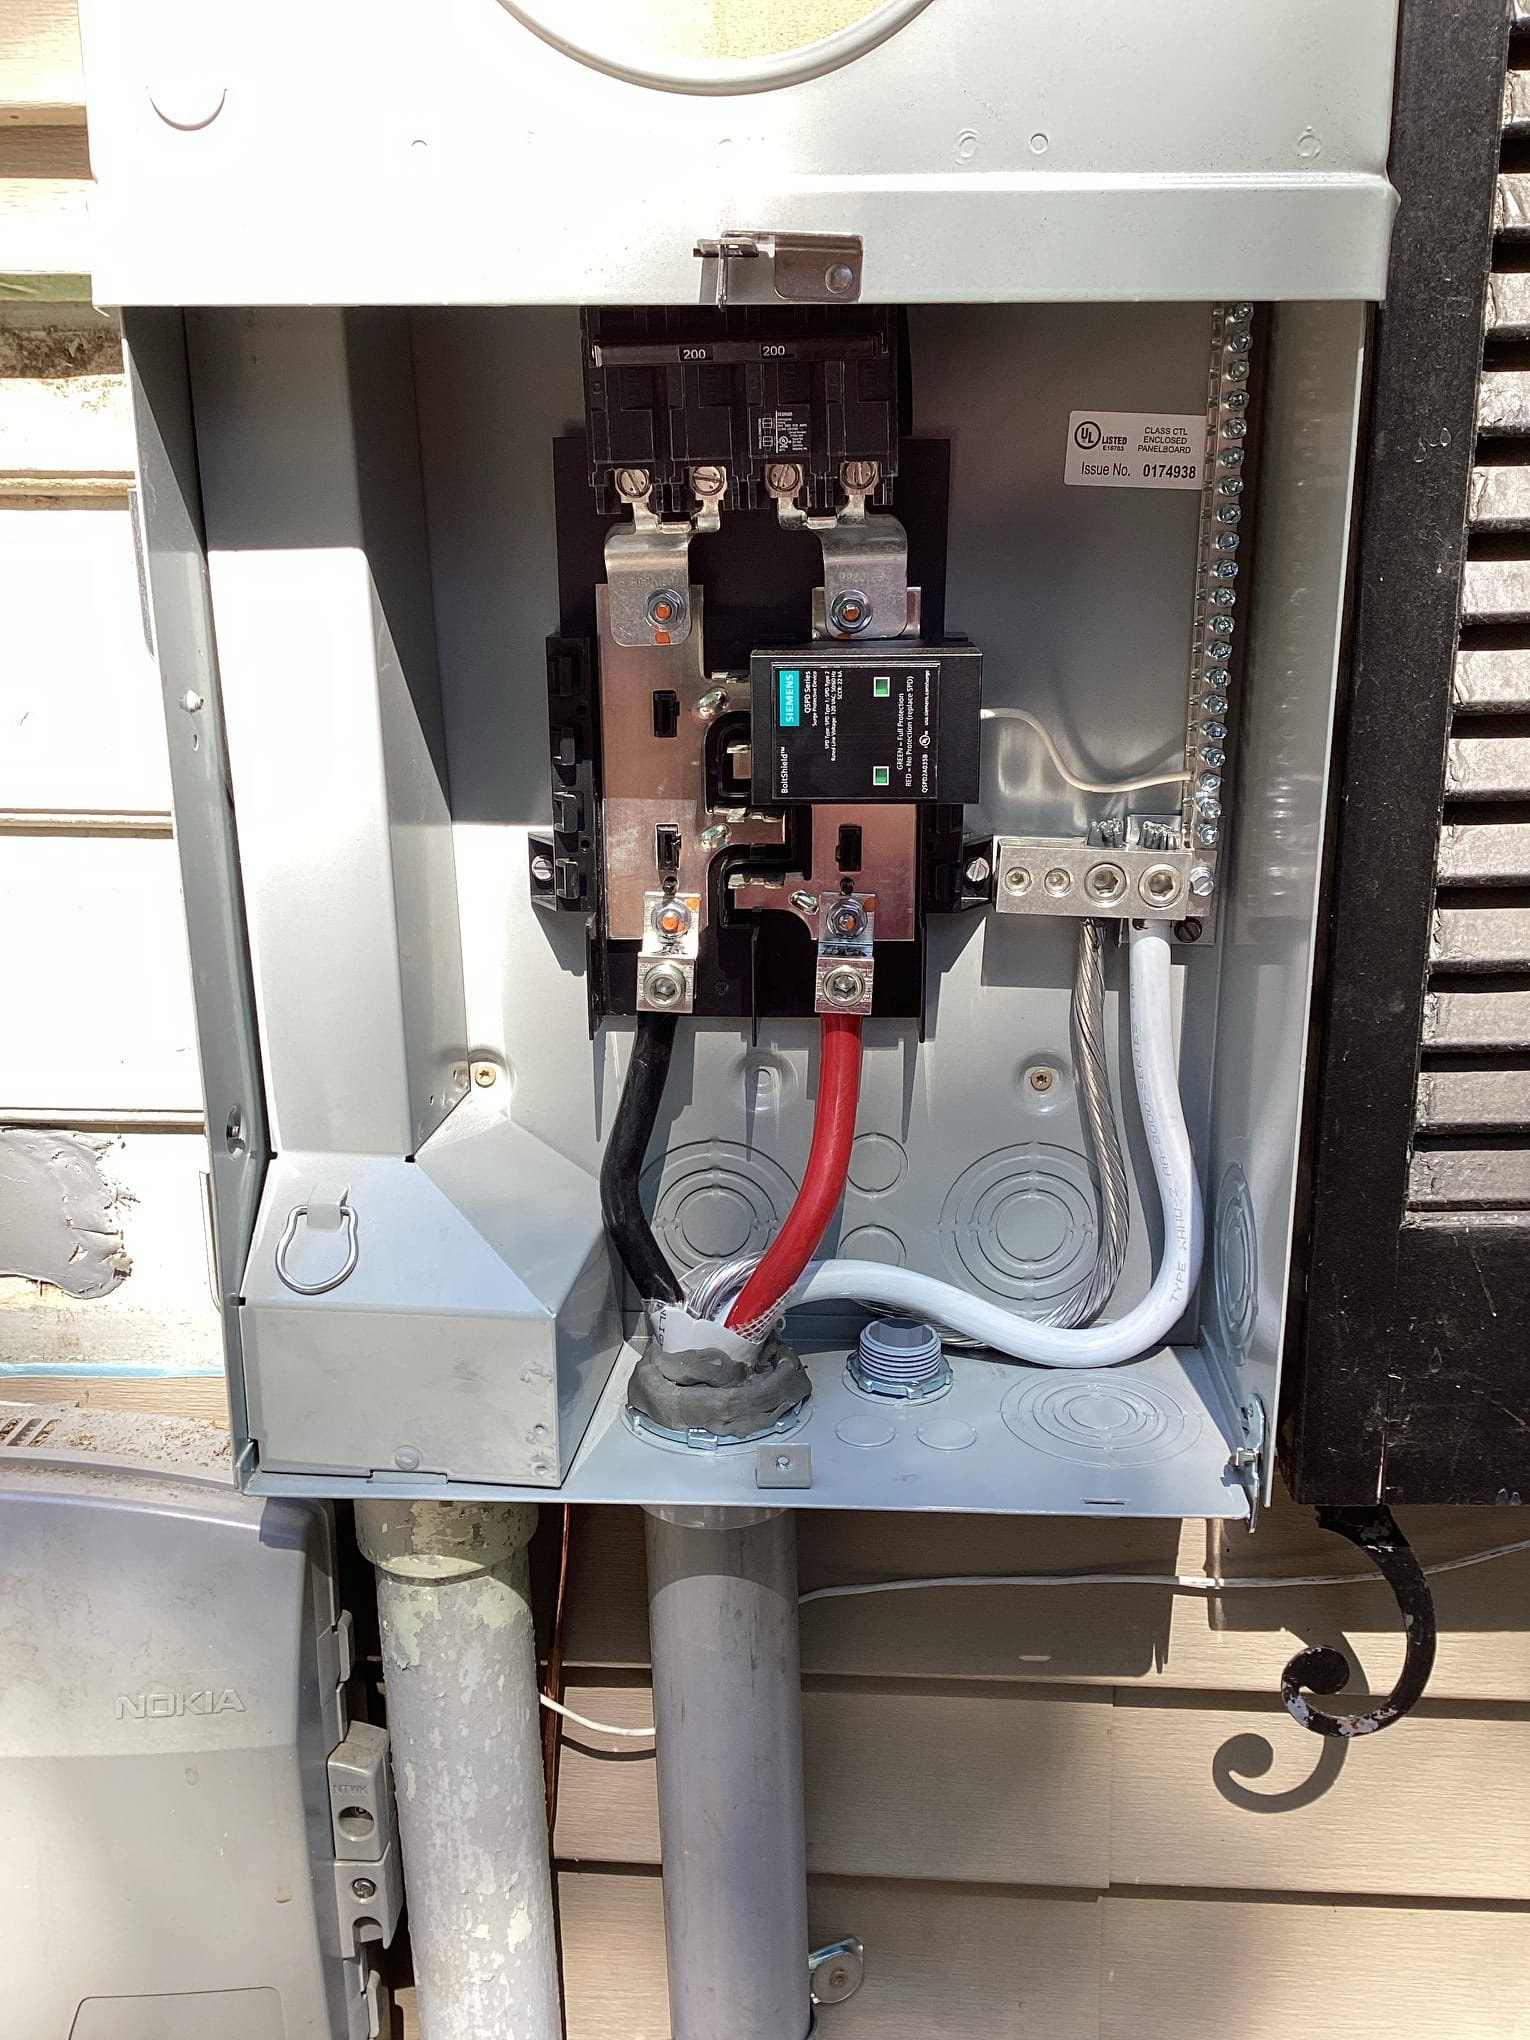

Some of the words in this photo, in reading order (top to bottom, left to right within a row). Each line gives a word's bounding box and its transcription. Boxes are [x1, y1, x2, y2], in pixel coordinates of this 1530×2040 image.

[683, 348, 706, 360] 200
[762, 345, 785, 357] 200
[1144, 426, 1171, 435] CLASS
[1172, 427, 1188, 436] CTL
[1101, 436, 1128, 445] LISTED
[1137, 444, 1191, 454] PANELBOARD
[1143, 436, 1187, 445] ENCLOSED
[1081, 461, 1110, 476] Issue
[1112, 462, 1131, 477] No.
[1143, 464, 1197, 479] 0174938
[906, 675, 914, 693] SPD)
[785, 674, 794, 723] SIEMENS
[804, 694, 812, 714] QSPD
[906, 693, 914, 720] (replace
[896, 728, 904, 741] Full
[896, 747, 904, 770] GREEN
[905, 756, 912, 767] No
[1168, 1187, 1188, 1251] XHHW-2
[1169, 1261, 1187, 1303] TYPE
[115, 1688, 246, 1719] NOKIA
